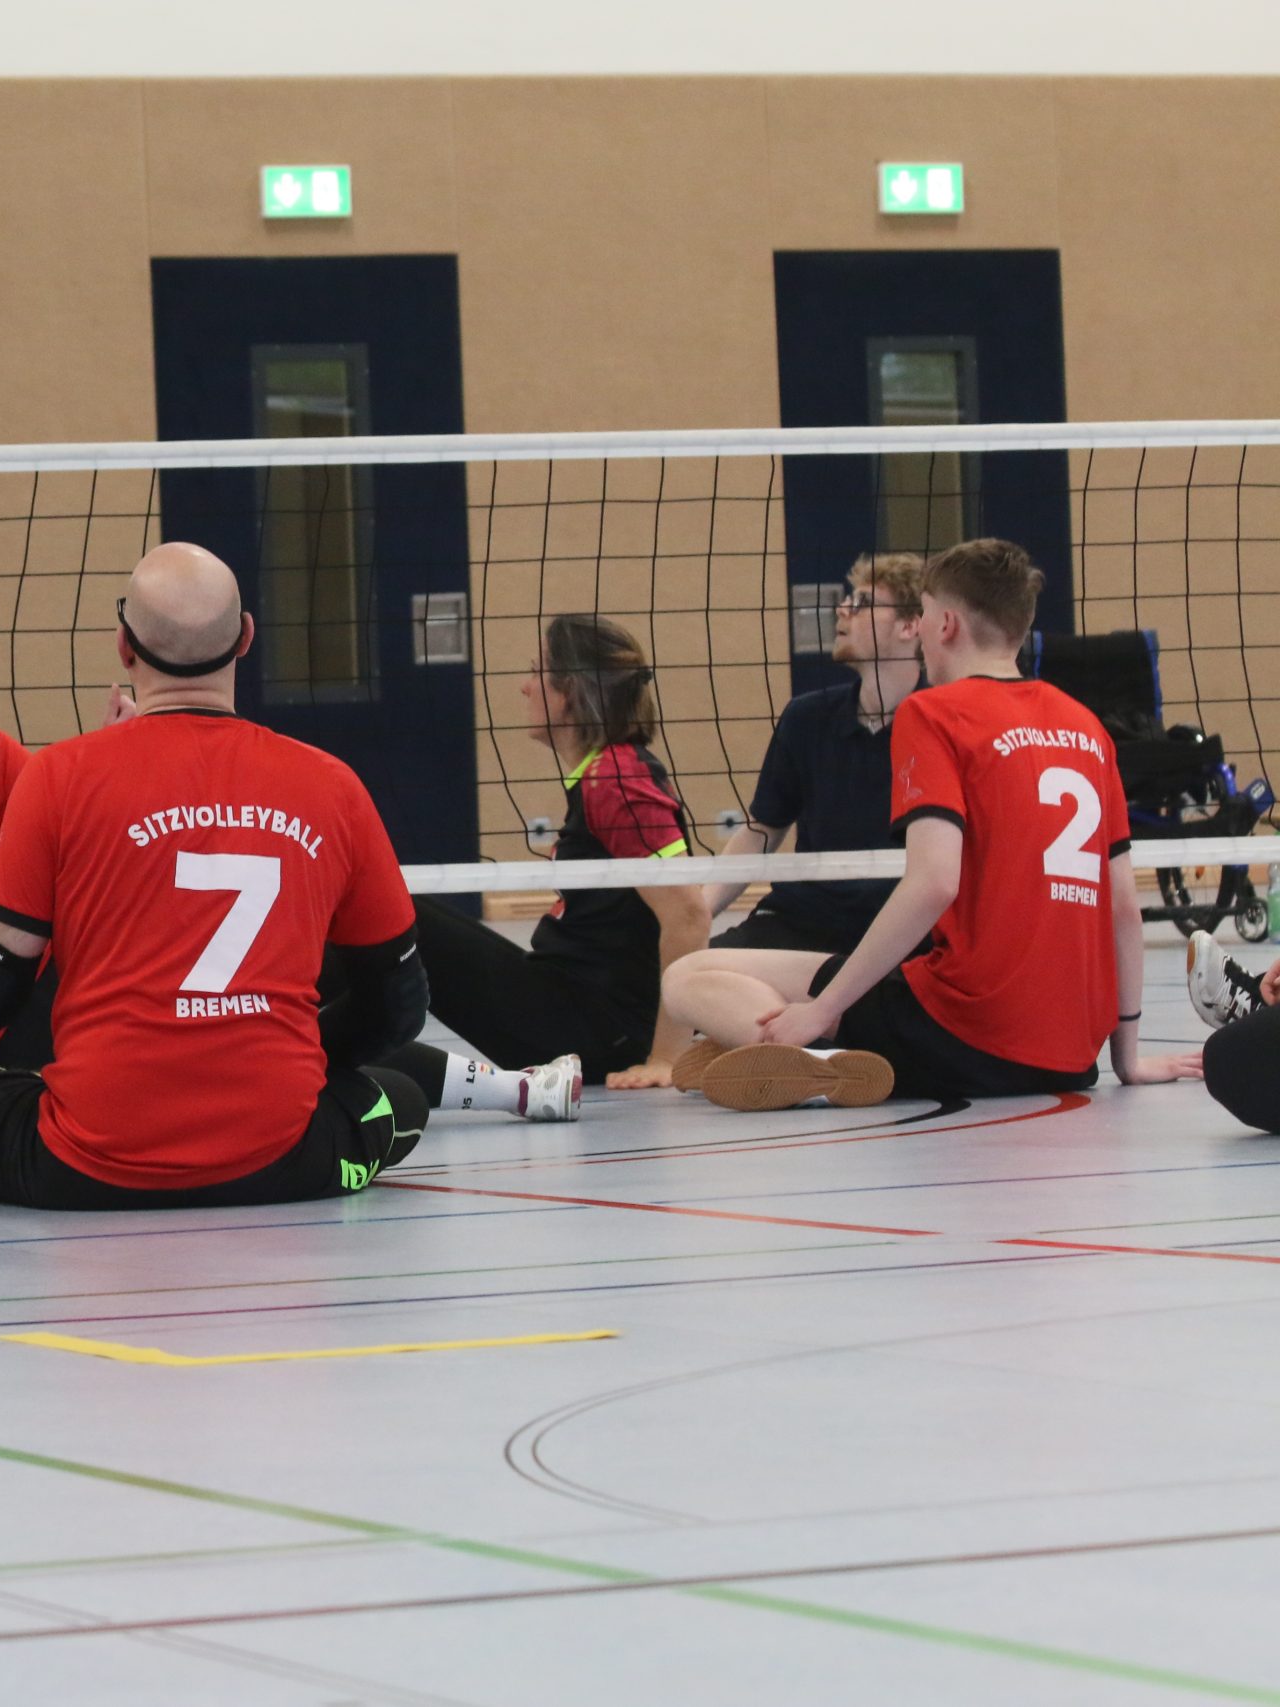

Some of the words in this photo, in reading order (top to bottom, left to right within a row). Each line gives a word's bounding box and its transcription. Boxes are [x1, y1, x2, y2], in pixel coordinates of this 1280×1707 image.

[127, 803, 323, 860] SITZVOLLEYBALL
[1038, 766, 1102, 883] 2
[174, 850, 281, 993] 7
[1050, 882, 1098, 907] BREMEN
[176, 994, 271, 1018] BREMEN
